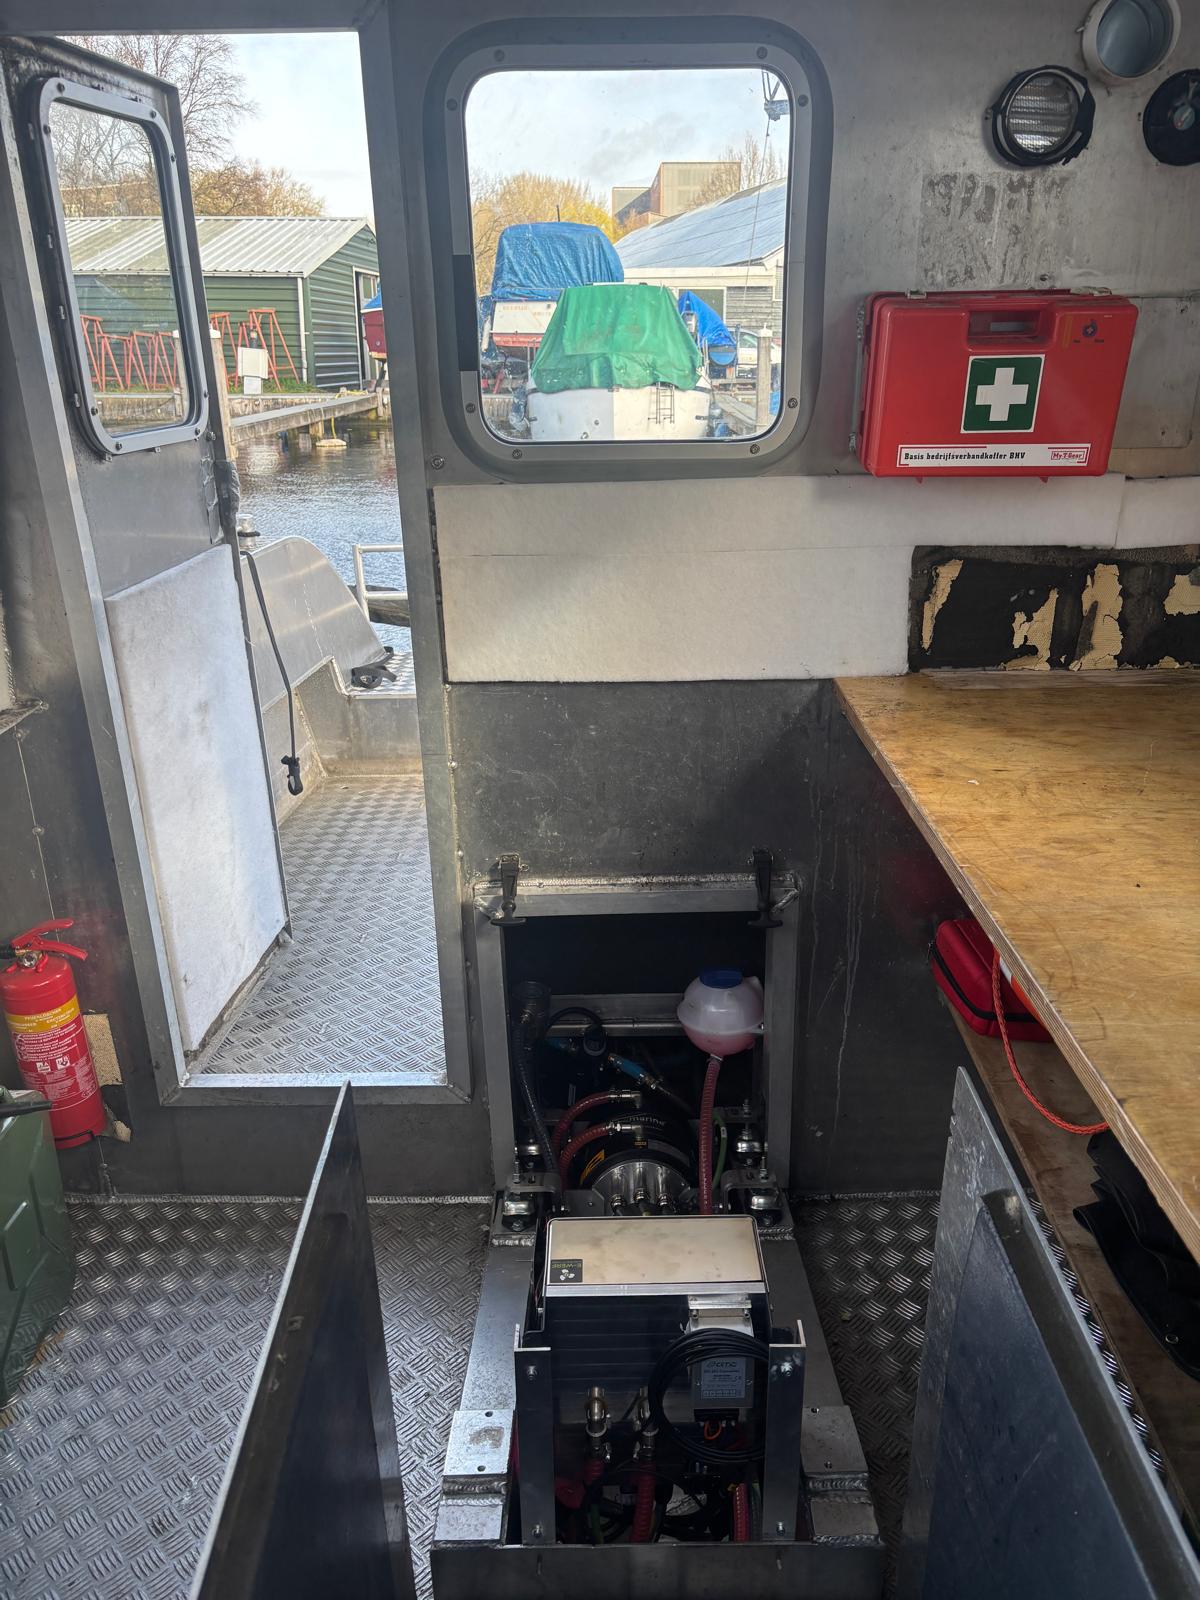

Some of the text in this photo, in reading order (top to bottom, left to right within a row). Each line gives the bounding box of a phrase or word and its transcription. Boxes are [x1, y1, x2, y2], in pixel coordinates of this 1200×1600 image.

[904, 452, 1026, 461] Basis bedrijfsverbandkoffer BHV
